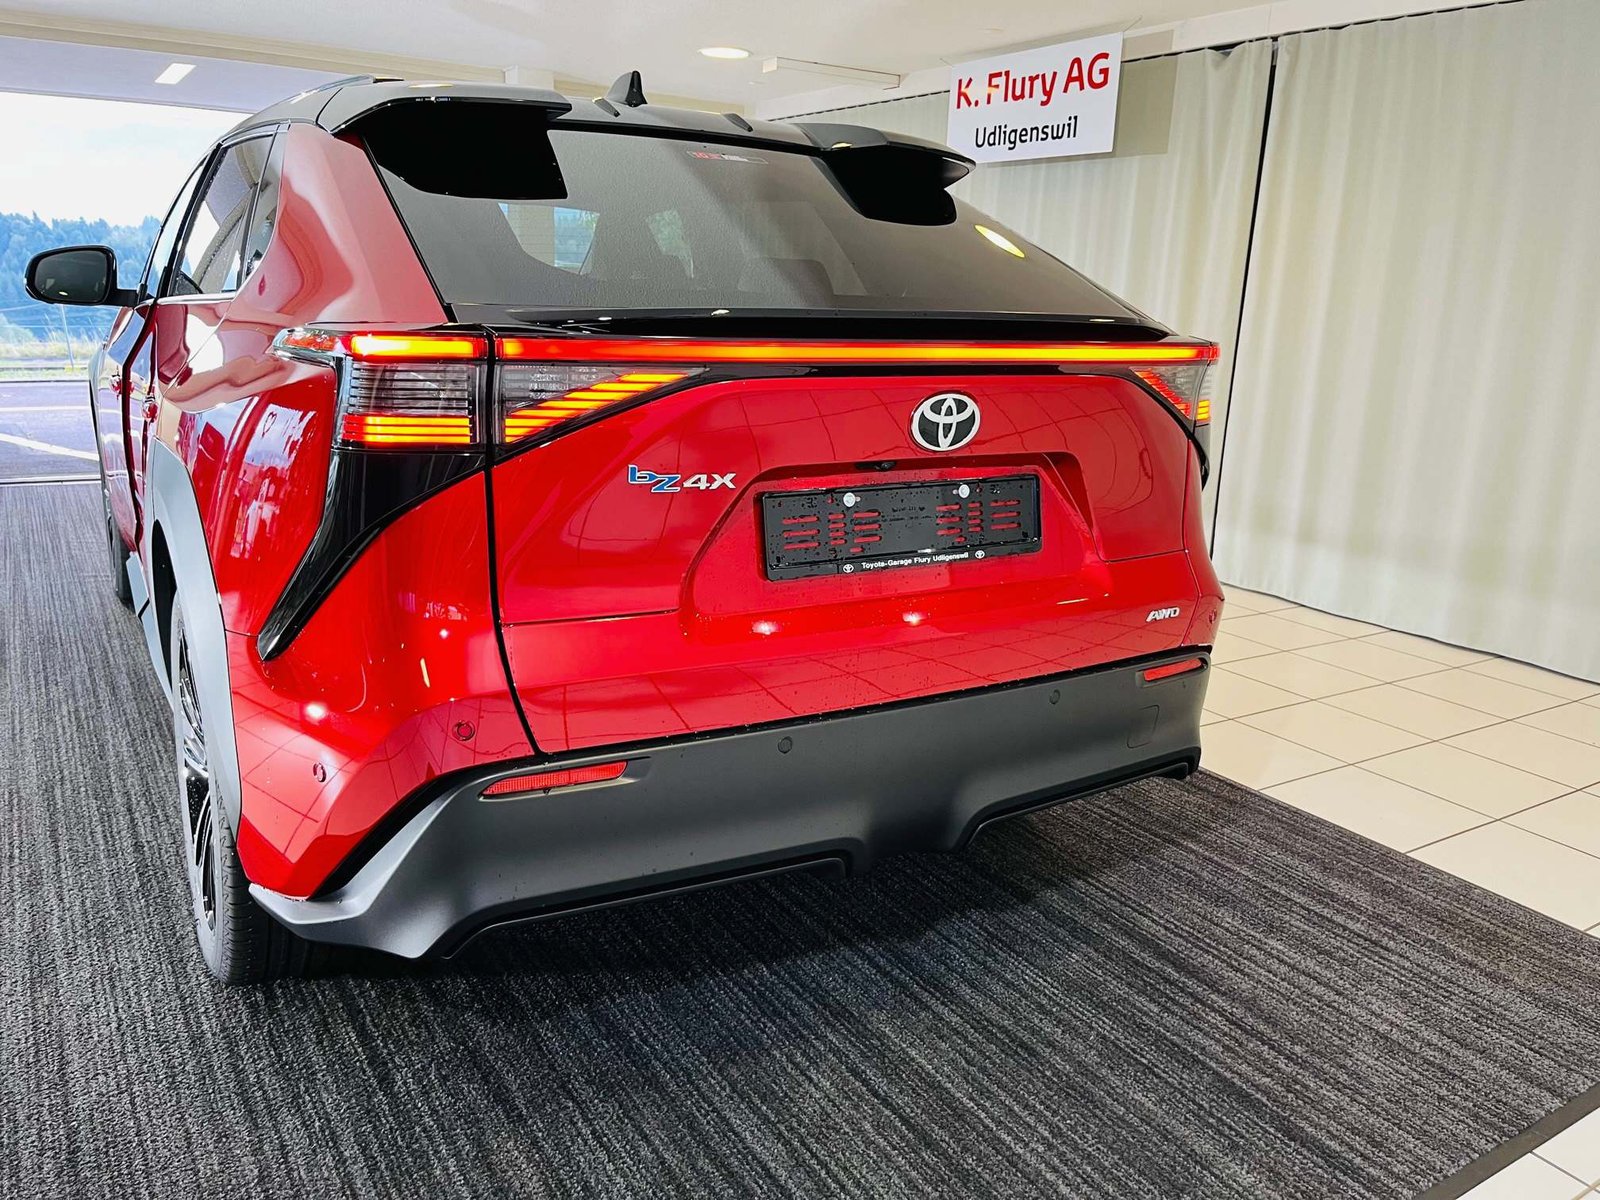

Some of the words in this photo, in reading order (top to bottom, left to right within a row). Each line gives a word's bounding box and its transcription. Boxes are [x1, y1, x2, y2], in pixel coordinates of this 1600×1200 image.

[956, 77, 979, 109] K.
[987, 70, 1057, 106] Flury
[1063, 52, 1110, 93] AG
[975, 115, 1078, 150] Udligenswil
[861, 559, 912, 569] Toyota-Garage
[1146, 607, 1180, 622] AWD
